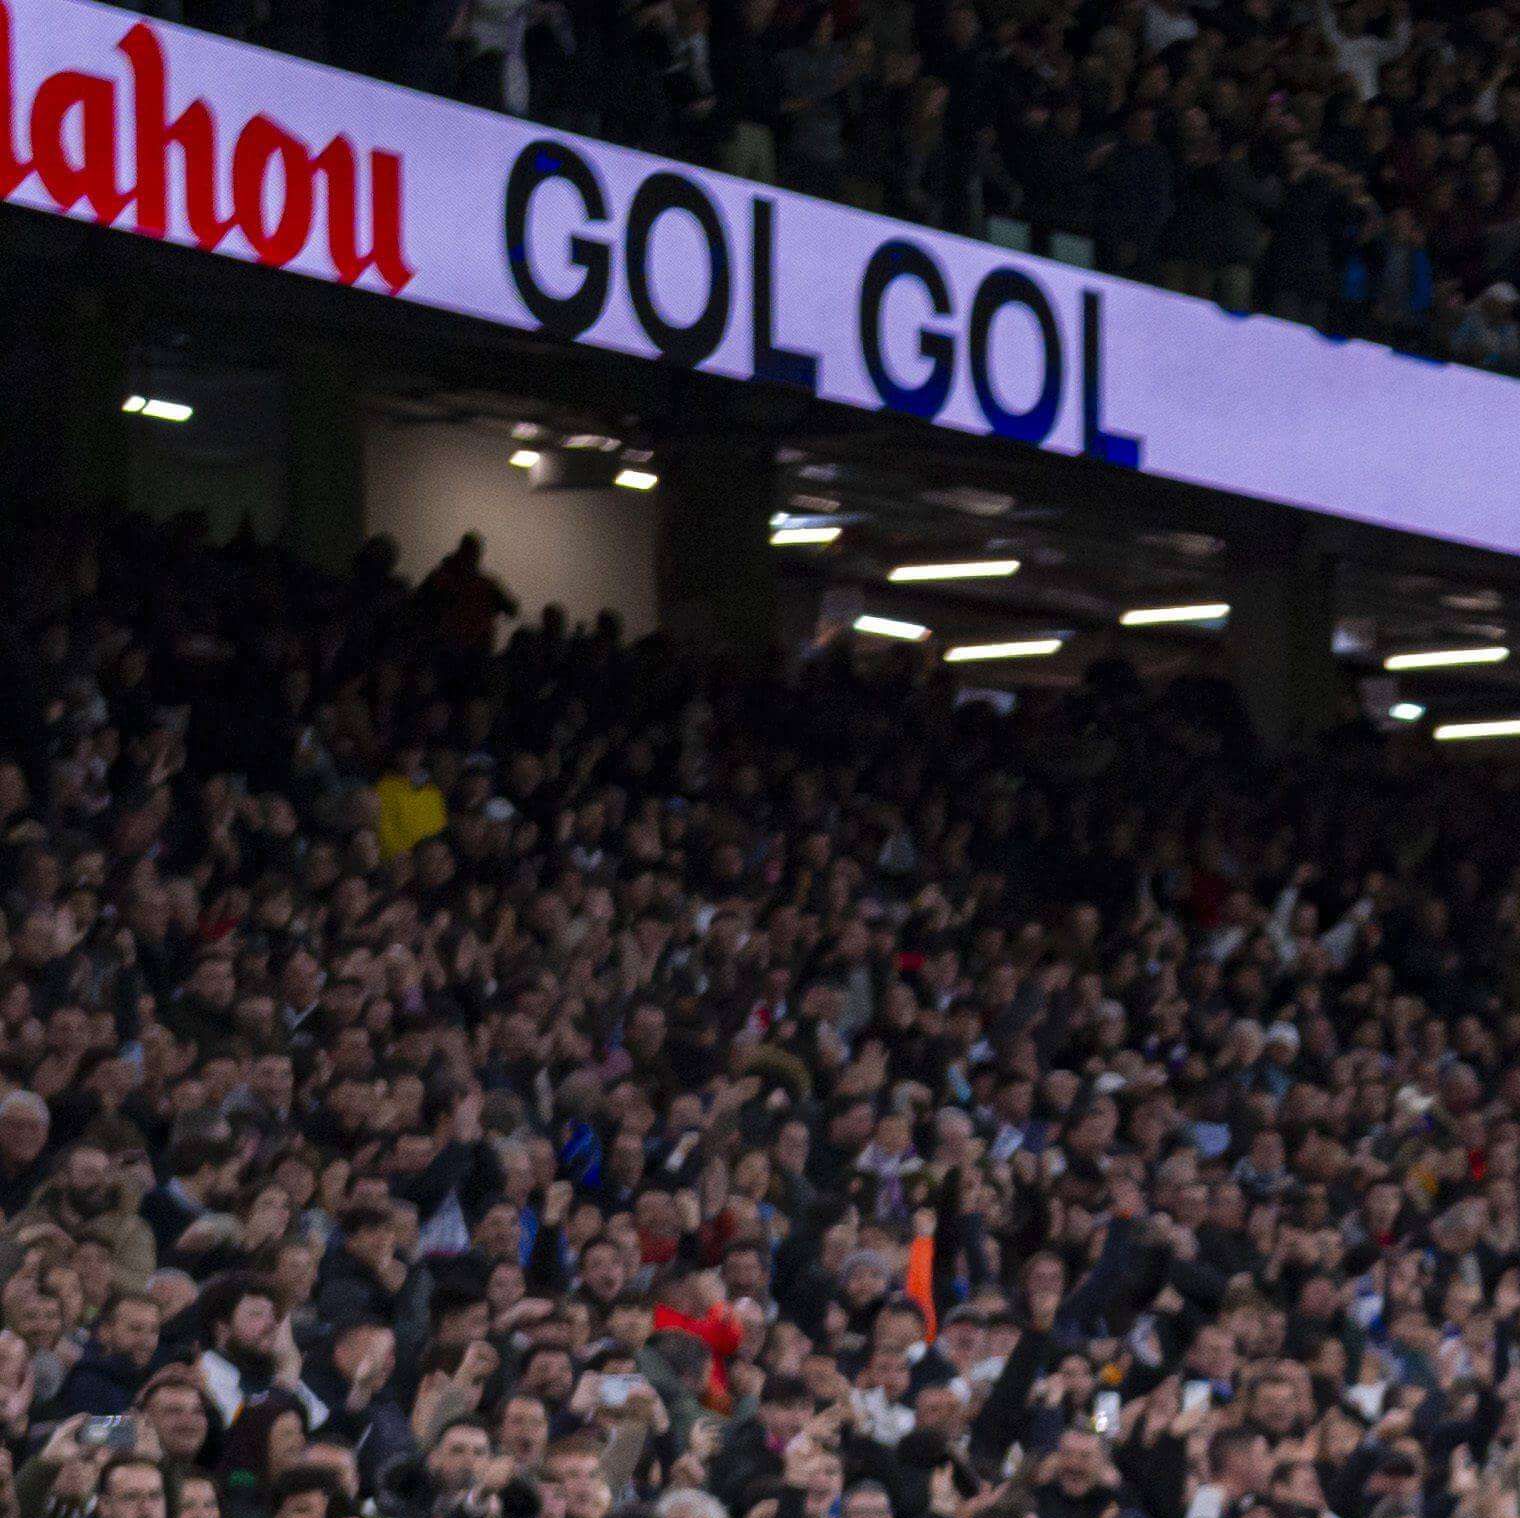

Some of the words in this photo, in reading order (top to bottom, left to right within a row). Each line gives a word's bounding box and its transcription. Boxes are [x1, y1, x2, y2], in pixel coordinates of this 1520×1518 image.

[0, 10, 414, 297] ahou
[504, 139, 819, 391] GOL
[858, 239, 1146, 471] GOL
